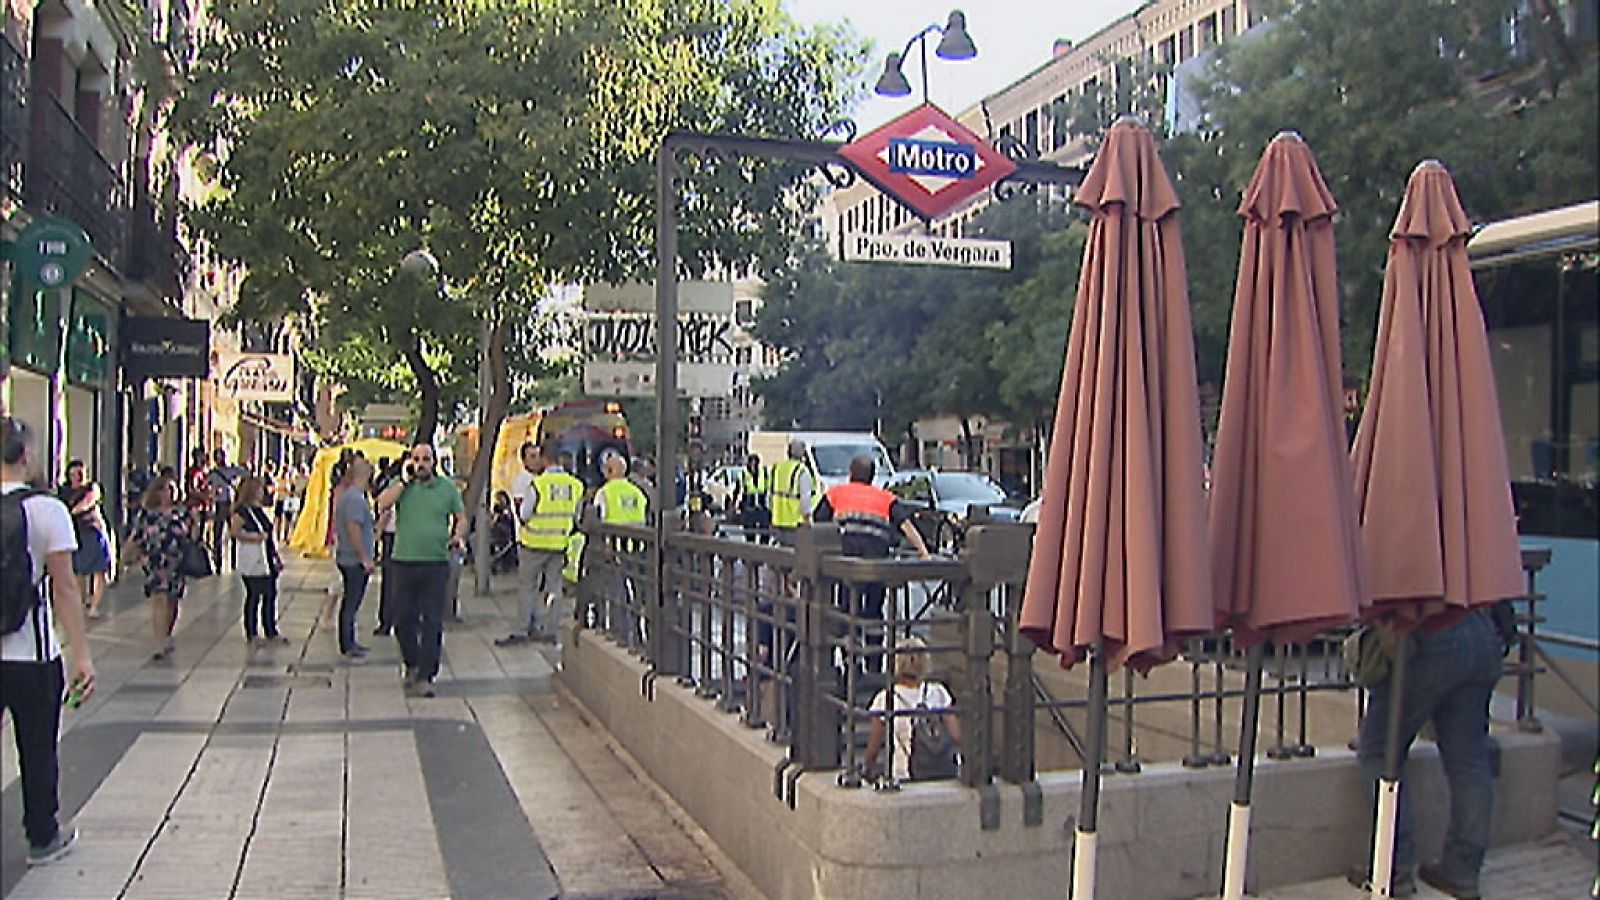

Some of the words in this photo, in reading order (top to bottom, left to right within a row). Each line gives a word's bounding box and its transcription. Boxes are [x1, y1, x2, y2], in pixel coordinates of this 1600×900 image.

[896, 143, 970, 173] Metro
[904, 239, 927, 259] de
[931, 240, 1001, 264] Vergara
